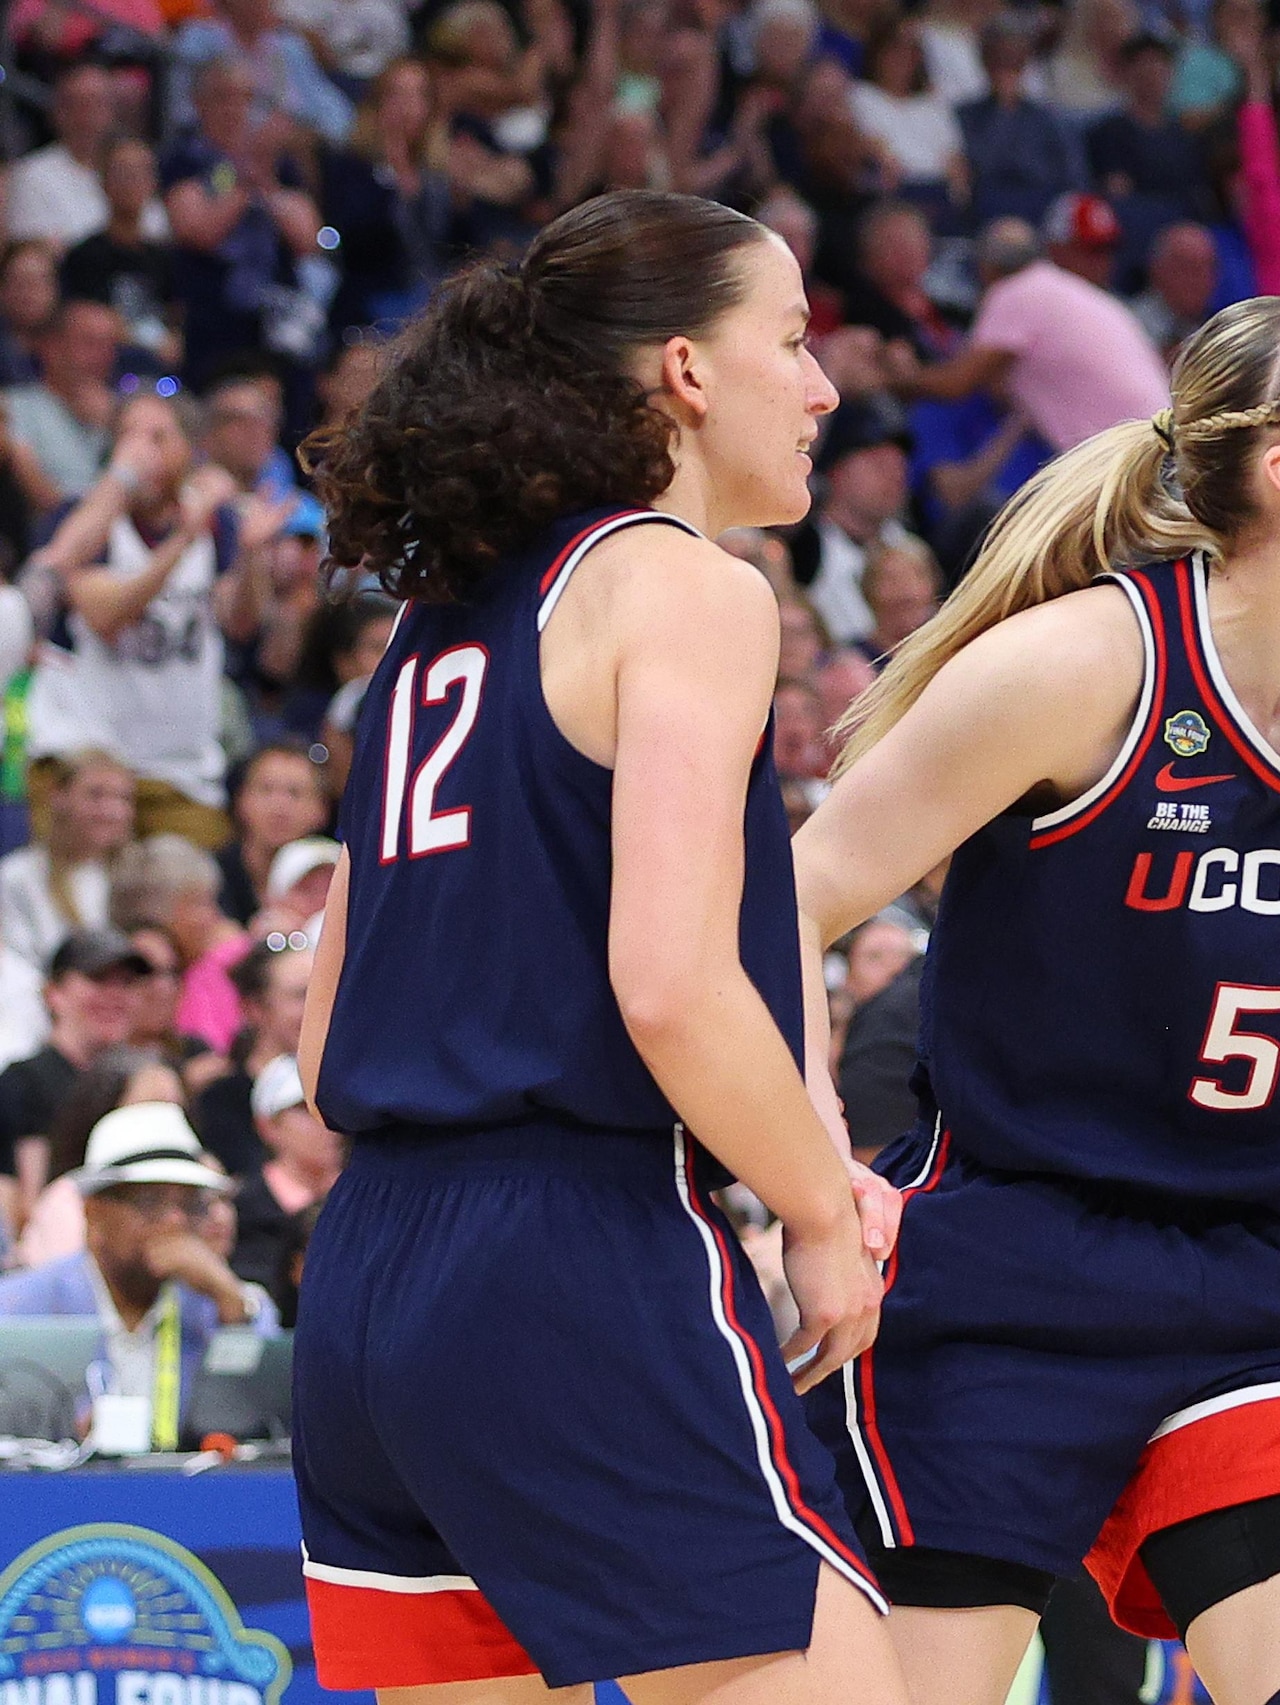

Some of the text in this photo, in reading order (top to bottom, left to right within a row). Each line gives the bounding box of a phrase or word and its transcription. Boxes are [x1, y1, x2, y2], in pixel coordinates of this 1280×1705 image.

[378, 641, 491, 866] 12
[1156, 802, 1210, 820] BE THE
[1147, 817, 1212, 833] CHANGE
